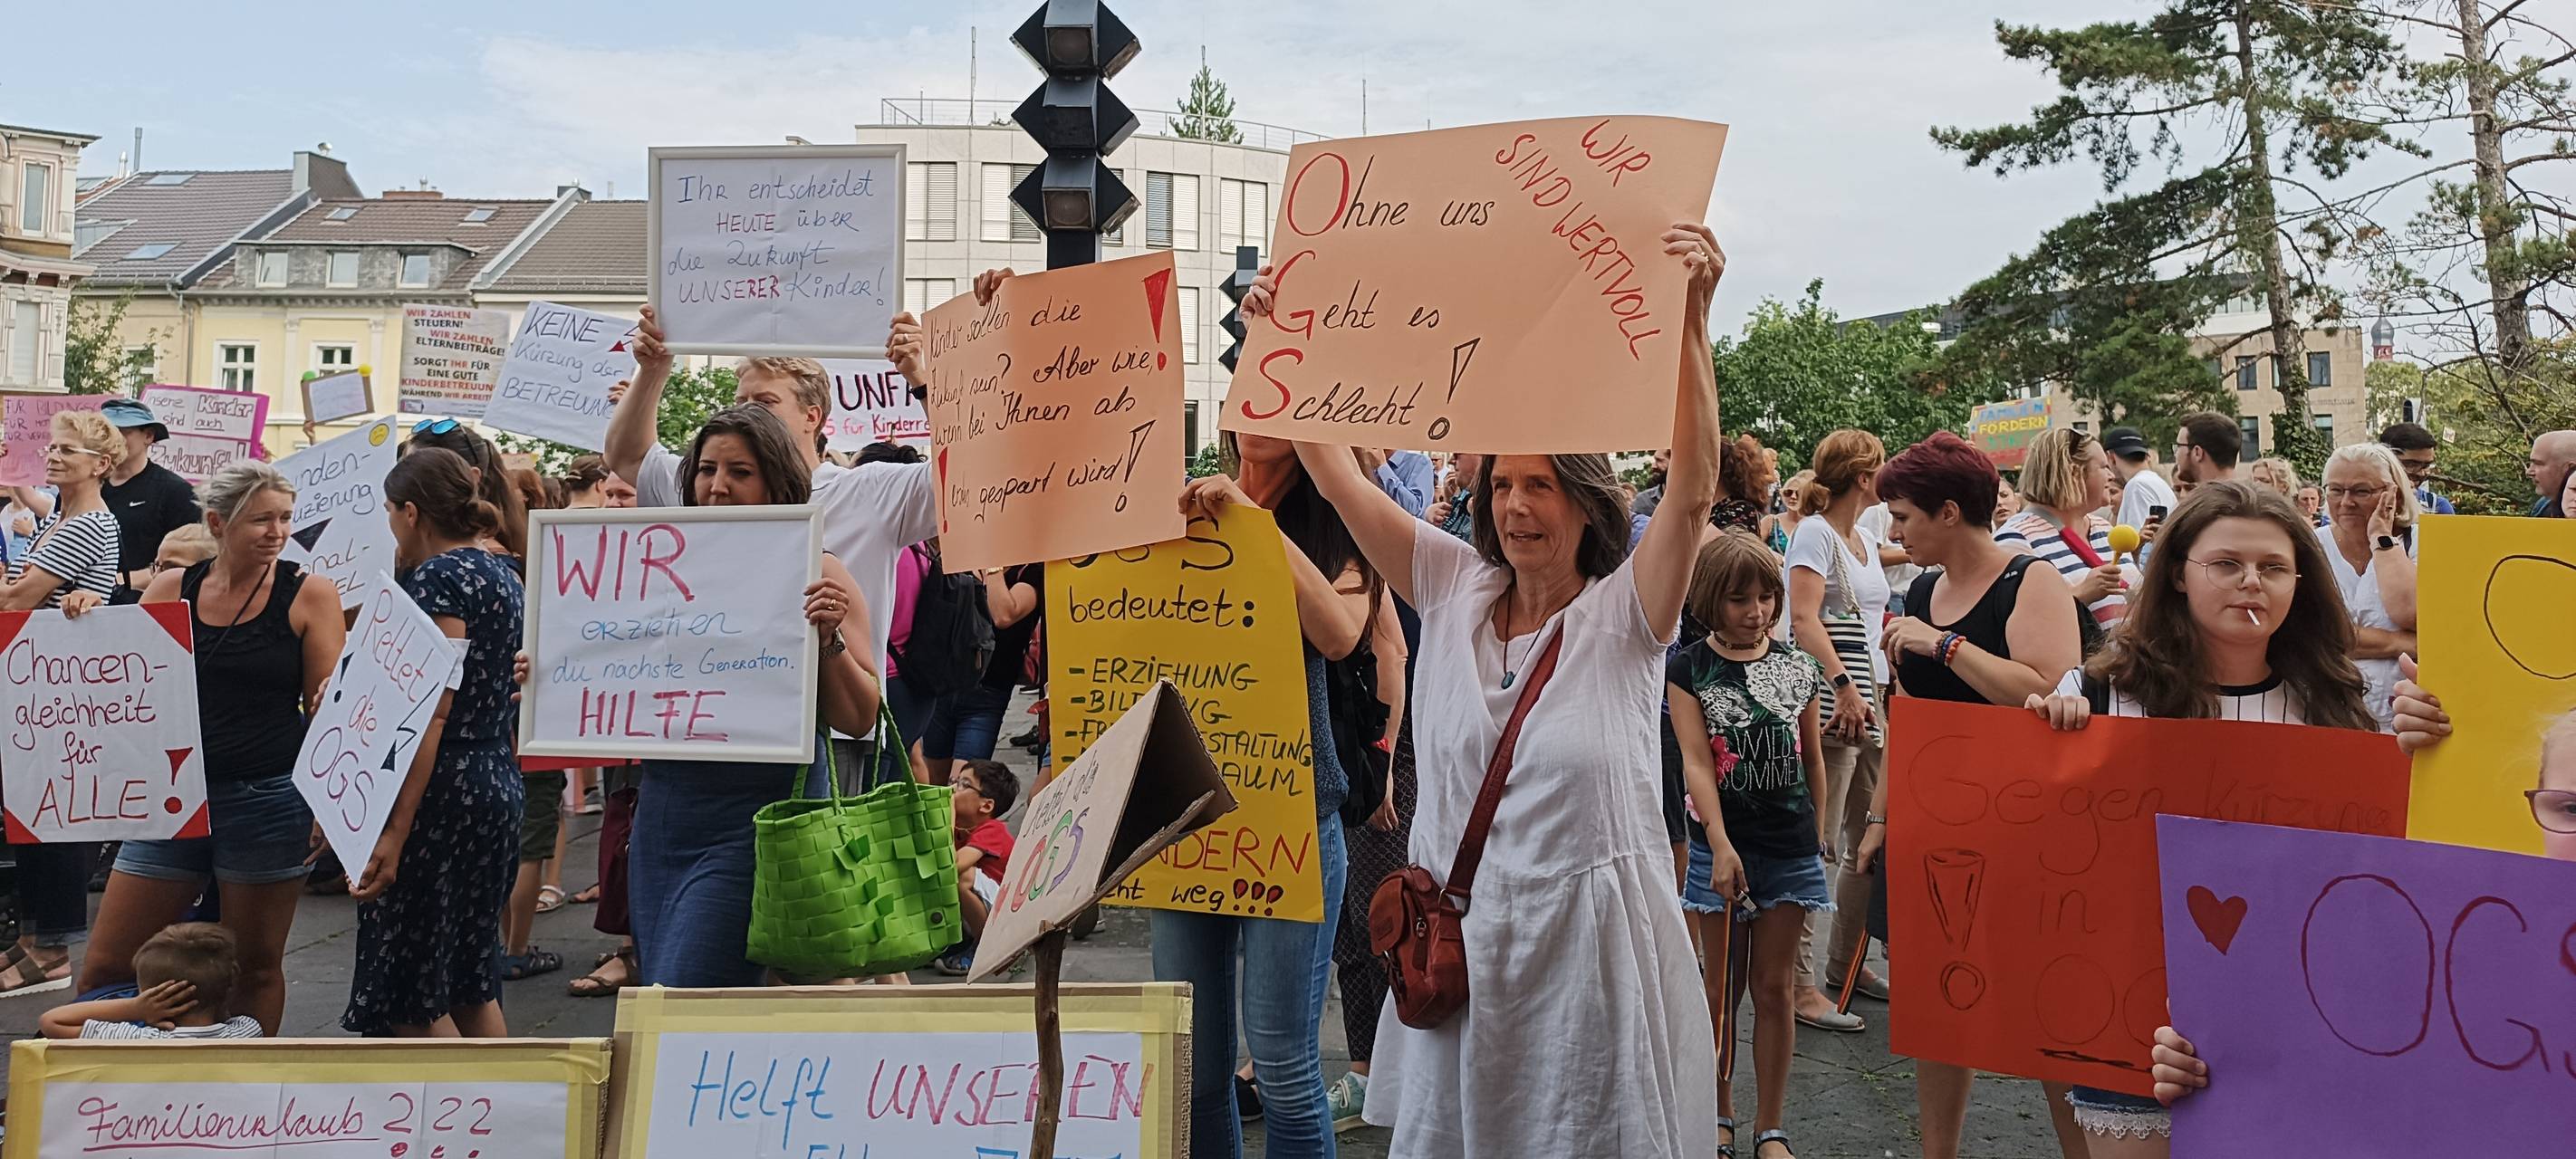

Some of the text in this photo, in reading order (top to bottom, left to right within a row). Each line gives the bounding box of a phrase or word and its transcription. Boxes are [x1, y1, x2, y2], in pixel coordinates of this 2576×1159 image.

[1580, 119, 1654, 187] WIR
[748, 169, 874, 200] entscheidet
[1286, 151, 1496, 237] Ohne uns
[716, 212, 776, 235] HEUTE
[726, 239, 835, 271] Zukunft
[1495, 133, 1662, 361] SIND WERTVOLL
[678, 274, 781, 303] UNSERER
[1269, 249, 1441, 342] Geht es
[406, 309, 471, 319] WIR ZAHLEN
[415, 319, 463, 328] STEUERN!
[525, 306, 604, 343] KEINE
[1030, 295, 1081, 328] die
[430, 330, 494, 345] WIR ZAHLEN
[414, 357, 490, 370] SORGT IHR FÜR
[428, 369, 479, 380] EINE GUTE
[514, 339, 623, 383] Kürzung der
[1033, 345, 1100, 384] Aber
[149, 396, 186, 408] nsere
[197, 394, 254, 417] Kinder
[401, 378, 495, 392] KINDERBETREUUN
[463, 393, 492, 402] ARBEIT
[163, 412, 224, 429] sind auch
[995, 389, 1071, 432] Ihnen
[293, 484, 376, 523] uzierung
[973, 461, 1056, 523] gespart
[553, 522, 696, 602] WIR
[1069, 584, 1255, 628] bedeutet:
[7, 637, 168, 685] Chancen-
[13, 688, 156, 751] gleichheit
[348, 684, 378, 747] die
[578, 686, 729, 742] HILFE
[62, 731, 102, 780] für
[1733, 724, 1797, 761] WILD
[310, 726, 374, 832] OGS
[1721, 753, 1803, 792] SUMMER
[1908, 734, 2166, 876] Gegen
[1011, 807, 1091, 913] OGS
[2037, 876, 2097, 935] in
[2301, 872, 2576, 1080] OG
[688, 1049, 834, 1151] Helft
